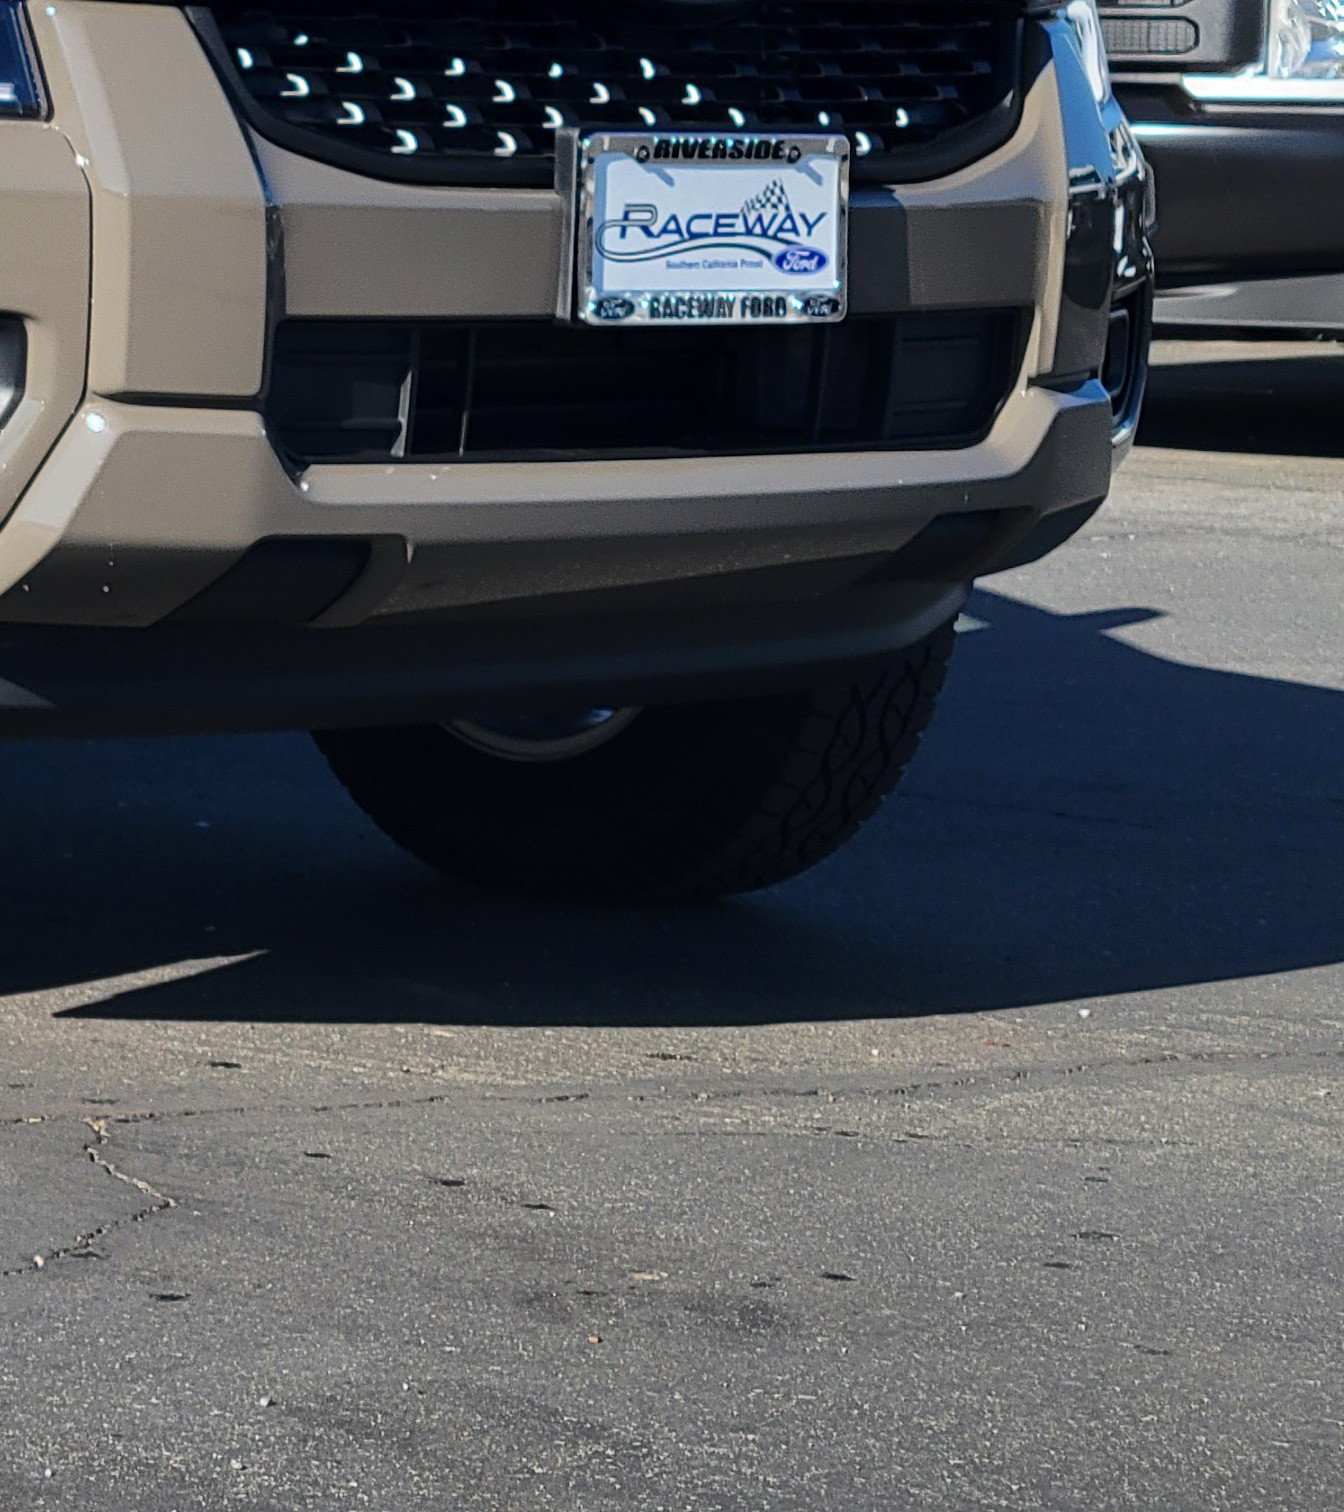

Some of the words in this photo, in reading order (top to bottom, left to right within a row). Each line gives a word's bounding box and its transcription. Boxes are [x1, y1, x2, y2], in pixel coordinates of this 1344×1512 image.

[653, 139, 785, 160] RIVERSIDE
[617, 204, 828, 239] RACEWAY
[783, 250, 818, 271] Ford
[649, 295, 736, 319] RACEWAY
[740, 295, 787, 318] FORD
